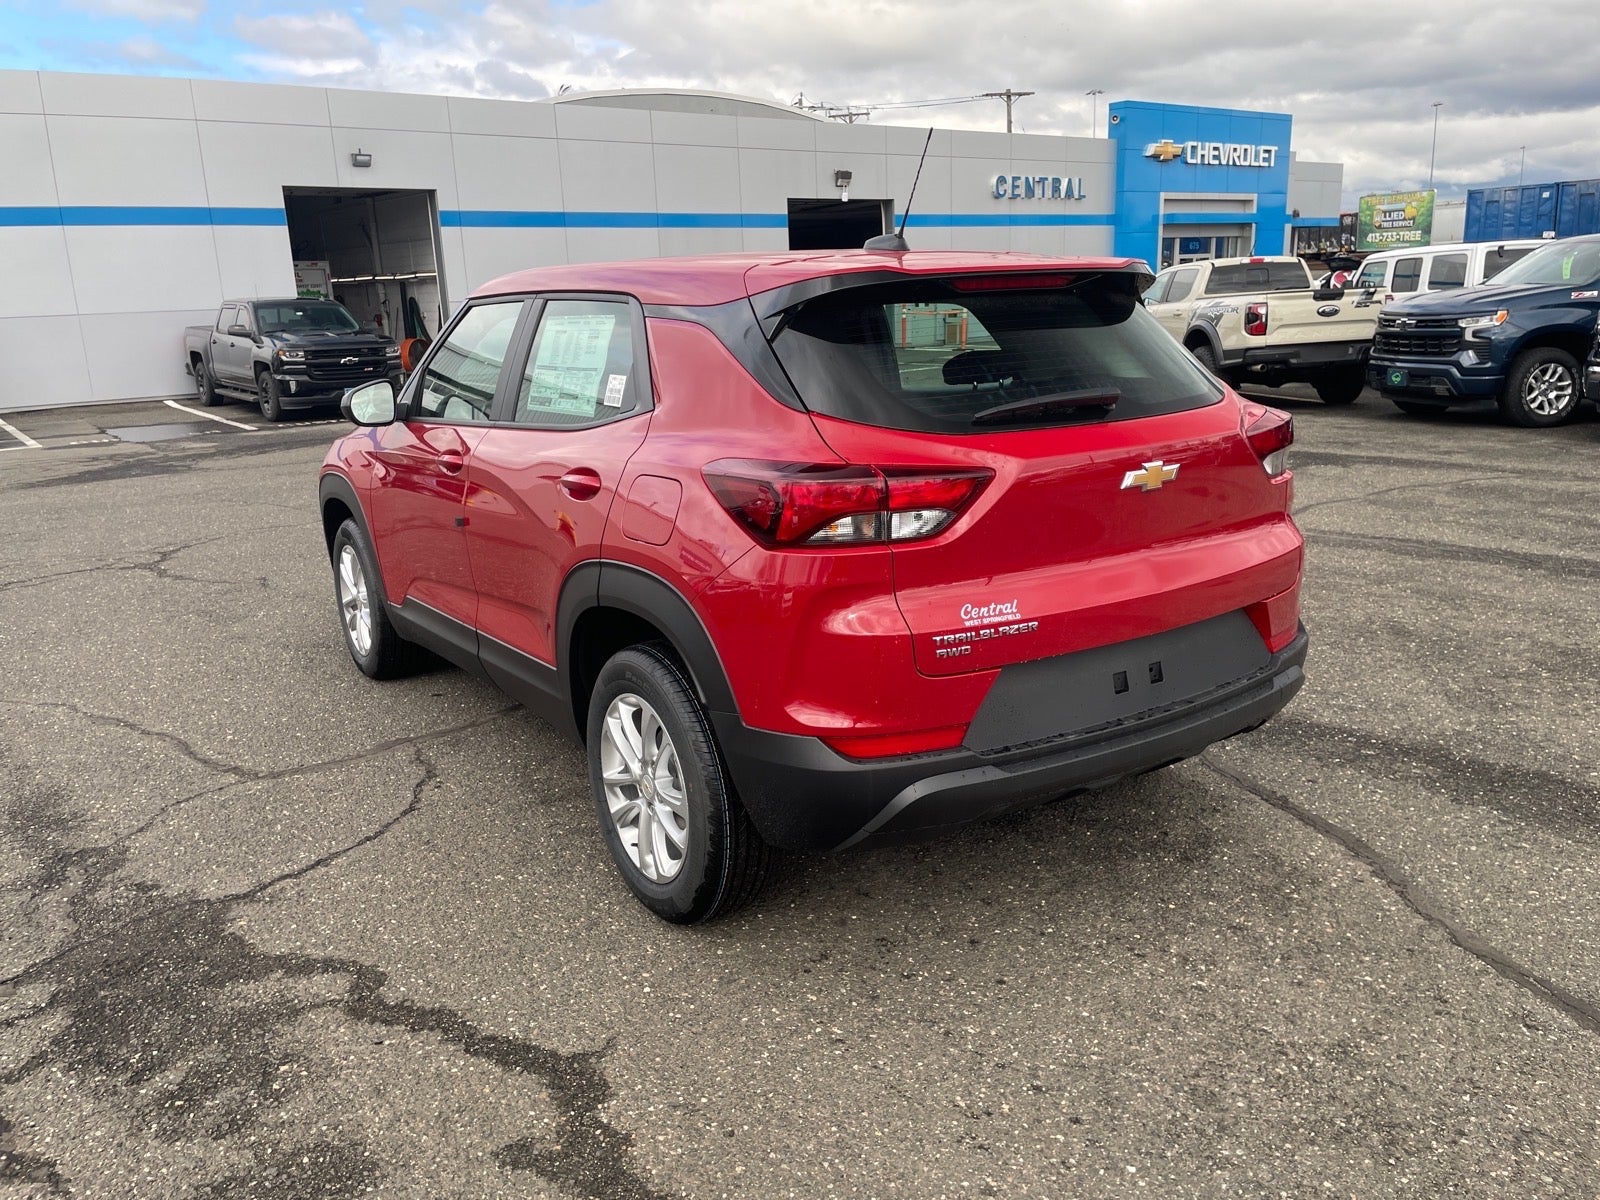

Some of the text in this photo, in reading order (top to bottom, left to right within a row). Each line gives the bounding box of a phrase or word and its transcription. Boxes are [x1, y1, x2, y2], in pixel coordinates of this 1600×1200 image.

[1186, 141, 1278, 167] CHEVROLET
[993, 175, 1086, 200] CENTRAL
[960, 599, 1018, 619] Central
[964, 613, 1022, 627] WEST SPRINGFIELD
[932, 621, 1039, 645] TRAILBLAZER
[936, 645, 972, 659] AWD
